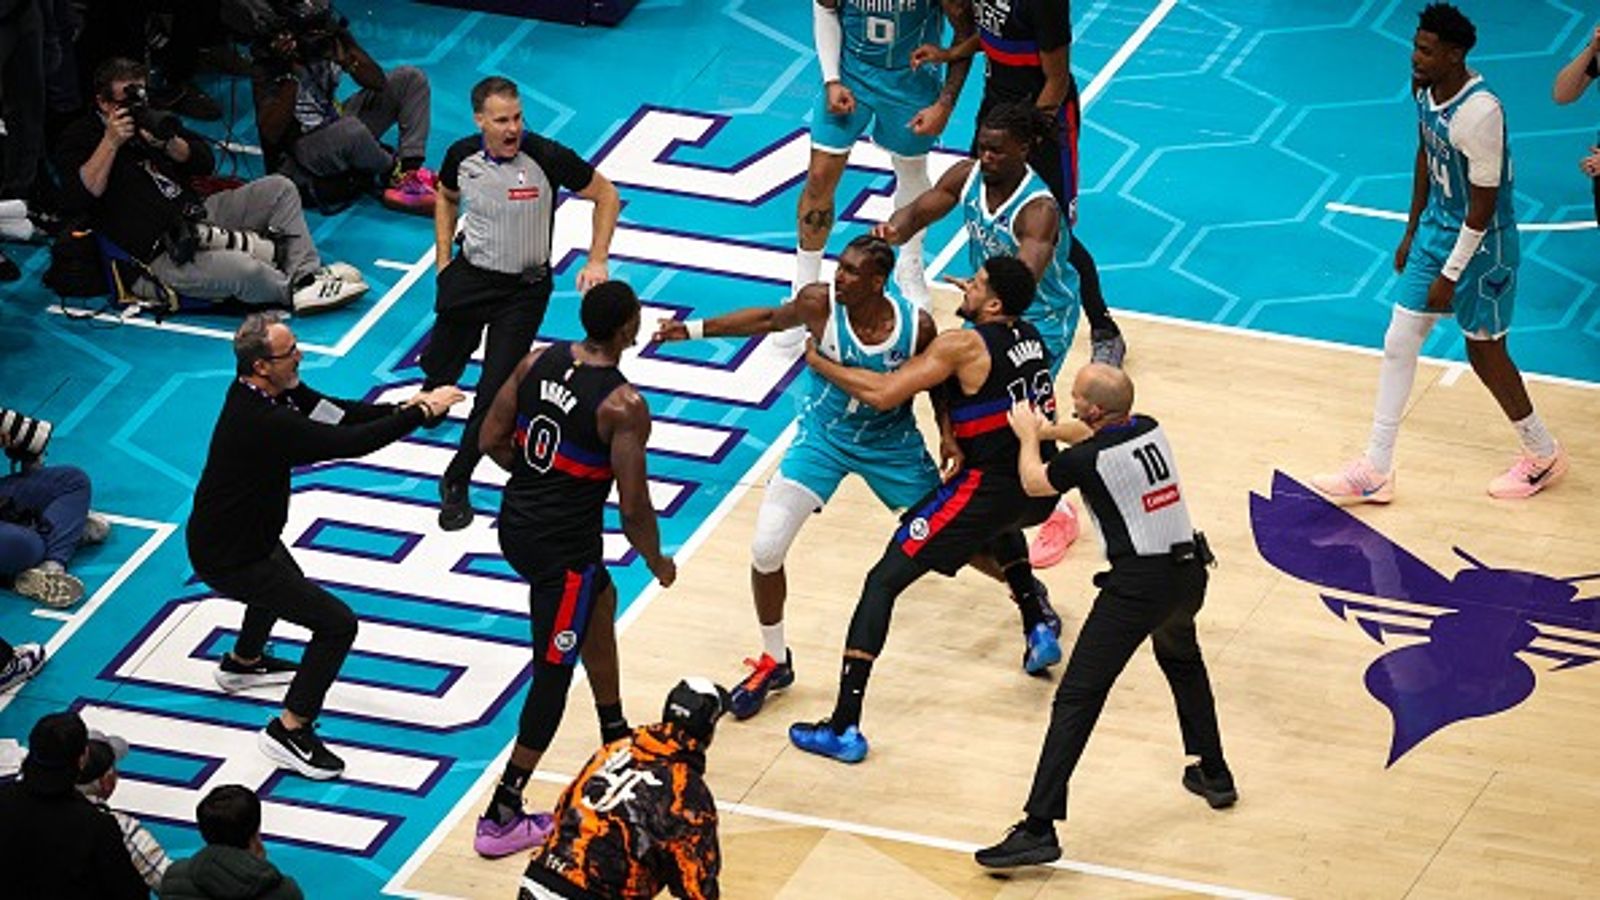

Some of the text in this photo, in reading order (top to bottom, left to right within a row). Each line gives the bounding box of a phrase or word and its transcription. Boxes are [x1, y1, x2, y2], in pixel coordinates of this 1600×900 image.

[866, 15, 897, 45] 0
[523, 413, 561, 474] 0
[1132, 442, 1170, 486] 10
